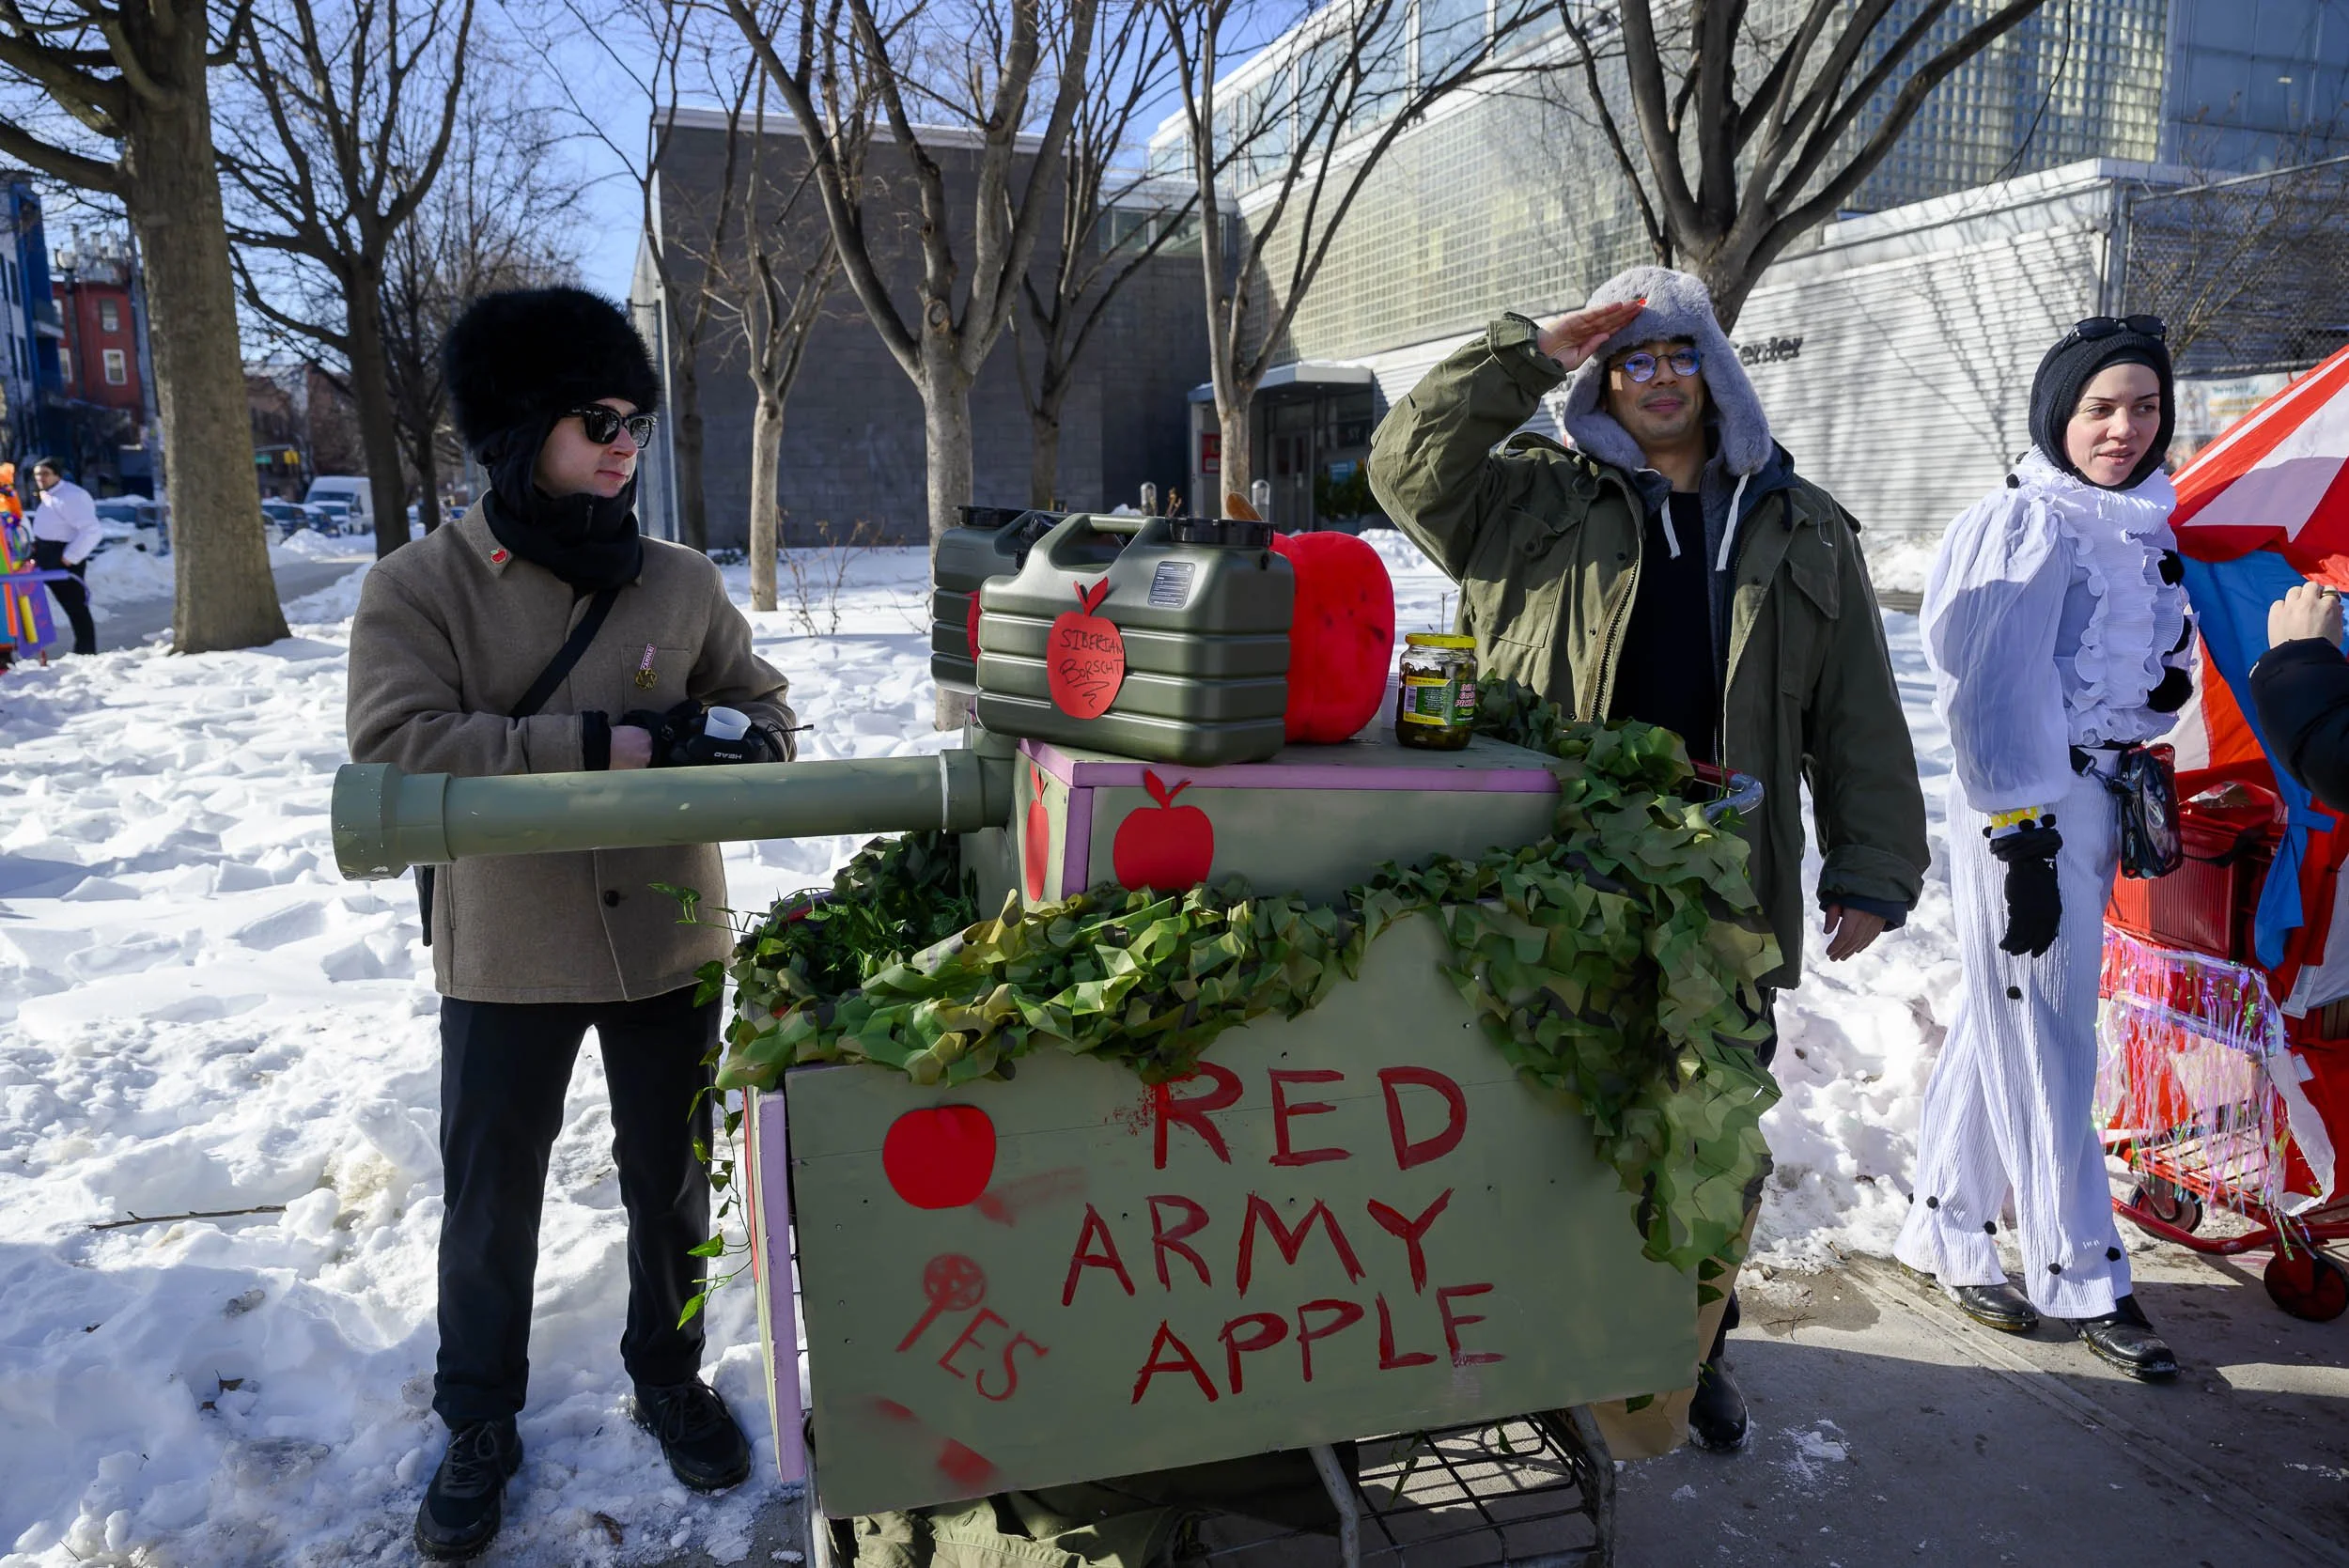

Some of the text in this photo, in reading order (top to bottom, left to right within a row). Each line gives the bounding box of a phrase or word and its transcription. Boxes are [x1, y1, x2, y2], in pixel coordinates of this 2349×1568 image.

[1729, 337, 1803, 366] enter
[1060, 628, 1124, 655] SIBERIAN
[714, 752, 742, 760] HEAD
[1153, 1061, 1468, 1171] RED
[1062, 1188, 1455, 1307] ARMY
[1130, 1282, 1506, 1405] APPLE
